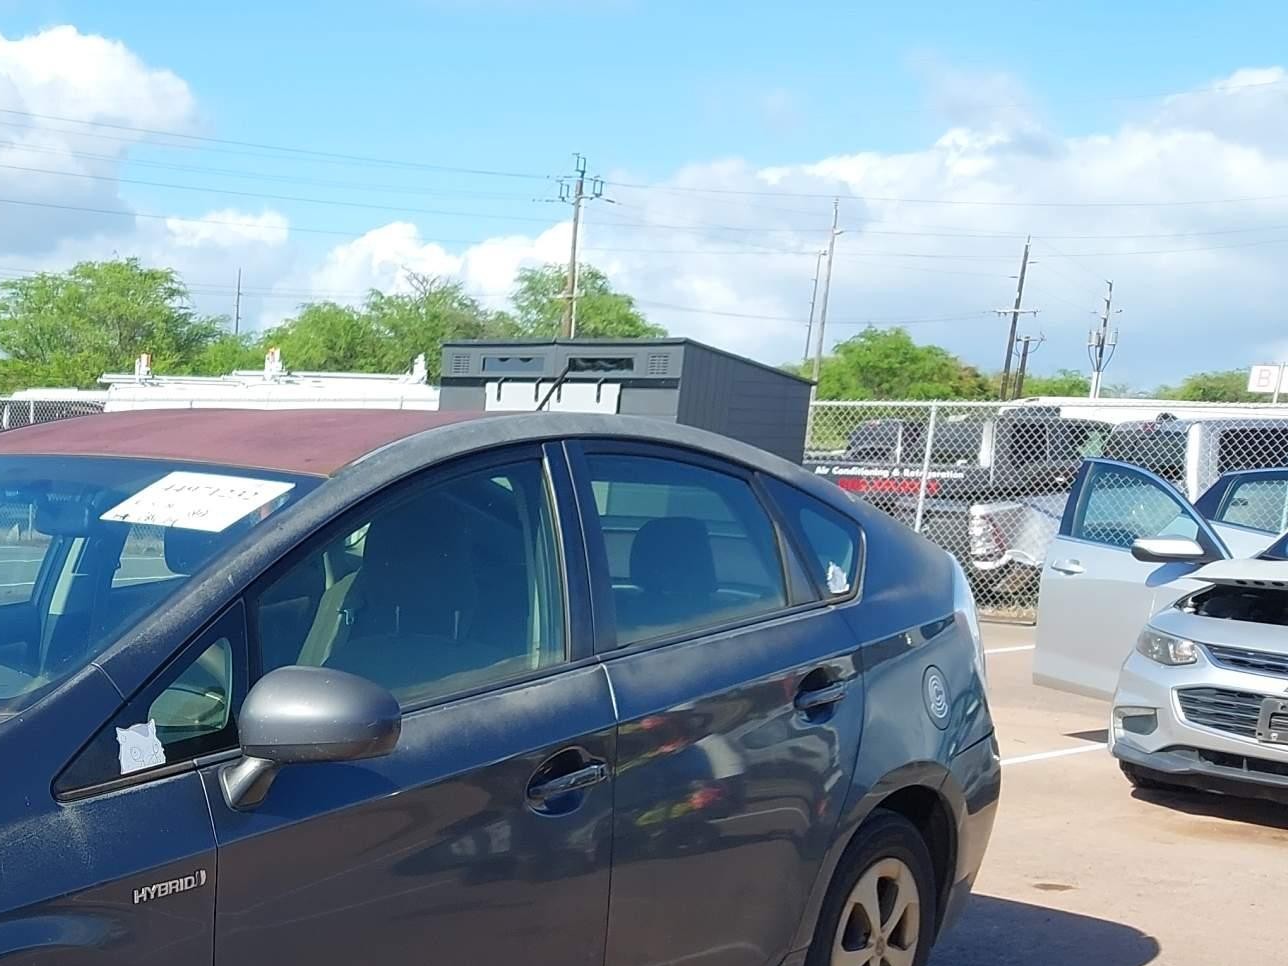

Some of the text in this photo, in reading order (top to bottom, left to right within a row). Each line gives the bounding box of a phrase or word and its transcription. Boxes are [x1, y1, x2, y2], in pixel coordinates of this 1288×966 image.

[814, 466, 831, 475] Air
[832, 466, 890, 478] Conditioning
[892, 468, 901, 476] &
[133, 875, 196, 904] HYBRID
